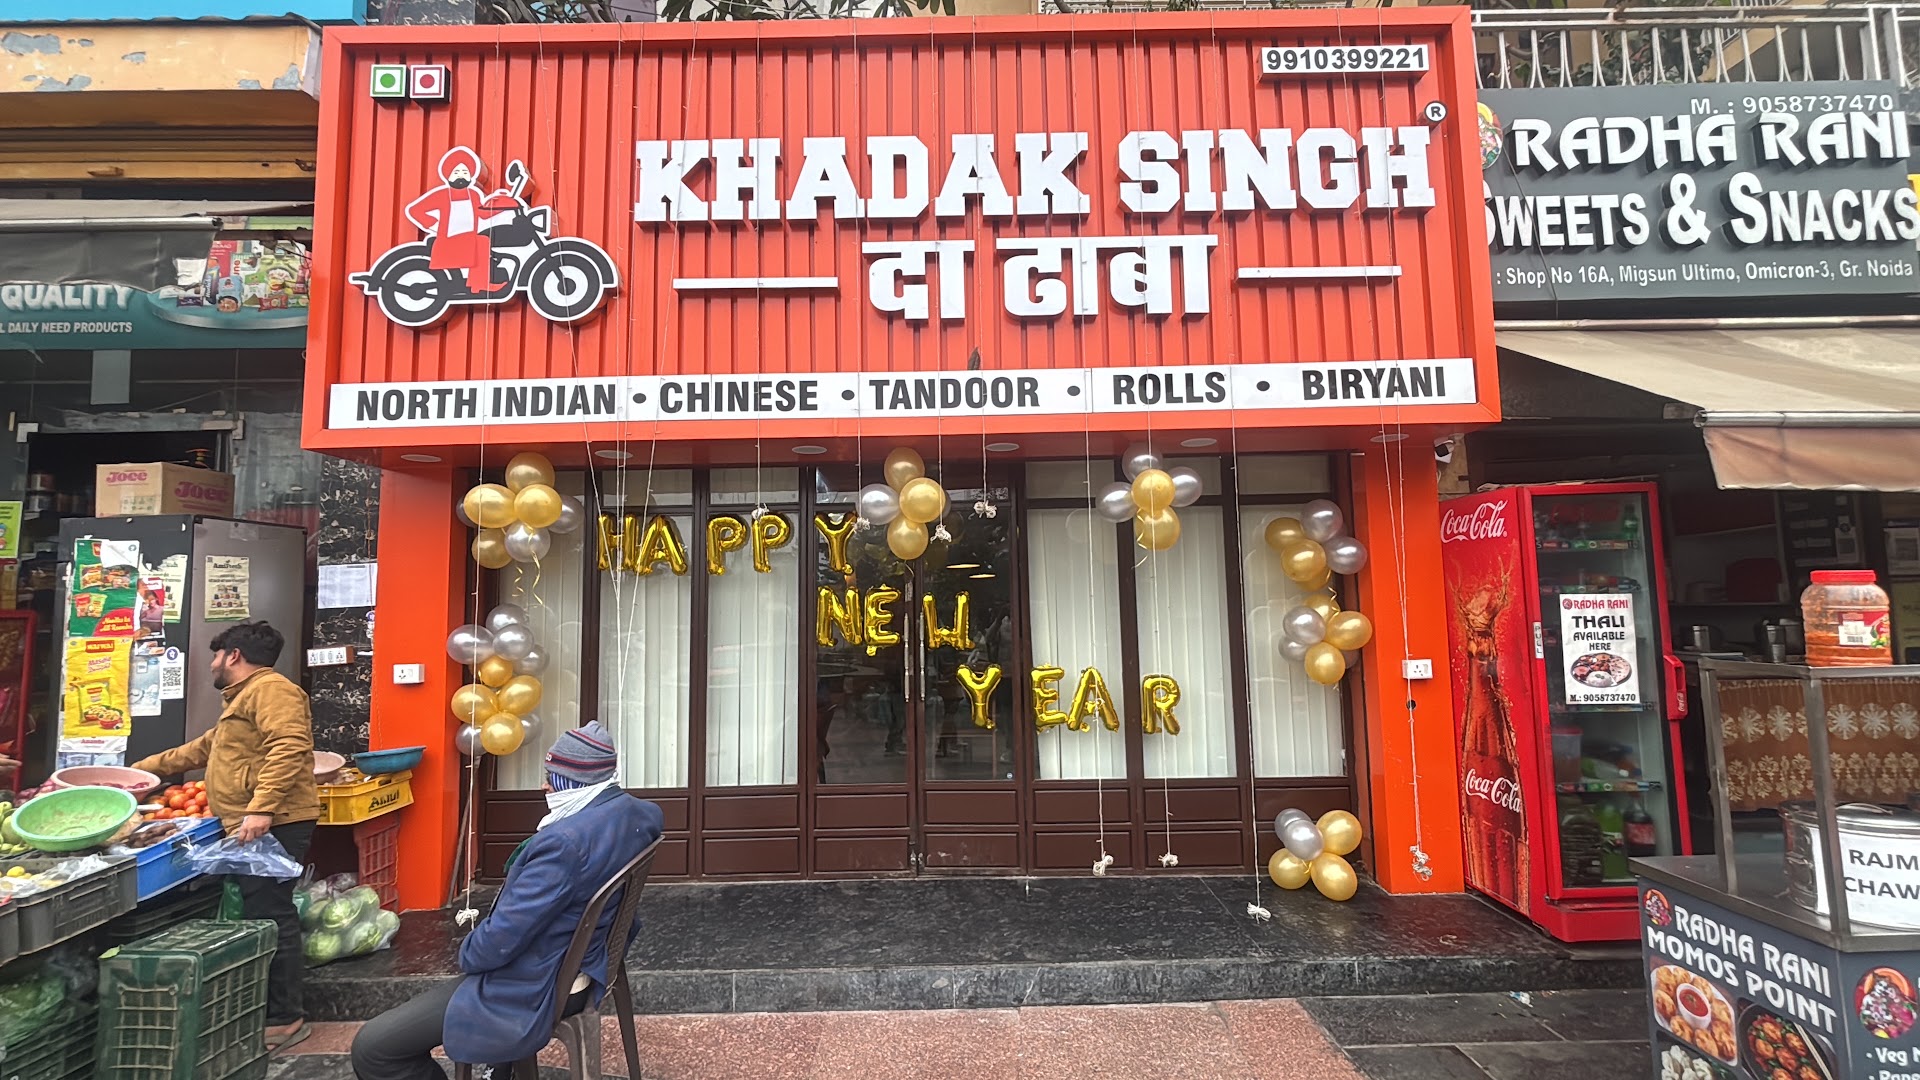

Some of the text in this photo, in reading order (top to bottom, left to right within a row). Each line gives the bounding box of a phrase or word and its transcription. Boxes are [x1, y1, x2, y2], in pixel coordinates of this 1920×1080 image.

[1266, 48, 1425, 70] 9910399221
[1742, 94, 1894, 114] 9058737470
[1511, 110, 1911, 172] RADHA RANI
[634, 132, 1090, 222] KHADAK
[1118, 126, 1436, 213] SINGH
[1483, 179, 1650, 247] WEETS
[1666, 172, 1712, 245] &
[862, 235, 1218, 320] दा ढाबा
[1506, 267, 1546, 288] Shop
[1551, 267, 1573, 284] No
[1578, 265, 1615, 286] 16A,
[1619, 264, 1677, 287] Migsun
[1682, 264, 1741, 283] Ultimo,
[1745, 260, 1835, 281] Omicron-3,
[1839, 259, 1863, 277] Gr.
[1867, 259, 1914, 277] Noida
[1, 284, 132, 311] QUALITY
[8, 322, 39, 333] DAILY
[41, 322, 71, 333] NEED
[73, 321, 133, 333] PRODUCTS
[356, 366, 1446, 421] NORTH INDIAN CHINESE TANDOOR ROLLS BIRYANI
[1440, 500, 1508, 544] Coca-Cola
[597, 512, 864, 576] HAPPY
[1574, 600, 1629, 610] RADHA RANI
[1572, 616, 1625, 629] THALI
[1573, 631, 1625, 641] AVAILABLE
[1589, 643, 1611, 651] HERE
[956, 664, 1182, 735] YEAR
[1583, 694, 1636, 702] 9058737470
[1674, 905, 1831, 999] RADHA RANI
[1647, 926, 1837, 1034] MOMOS POINT
[1875, 1047, 1908, 1066] Veg
